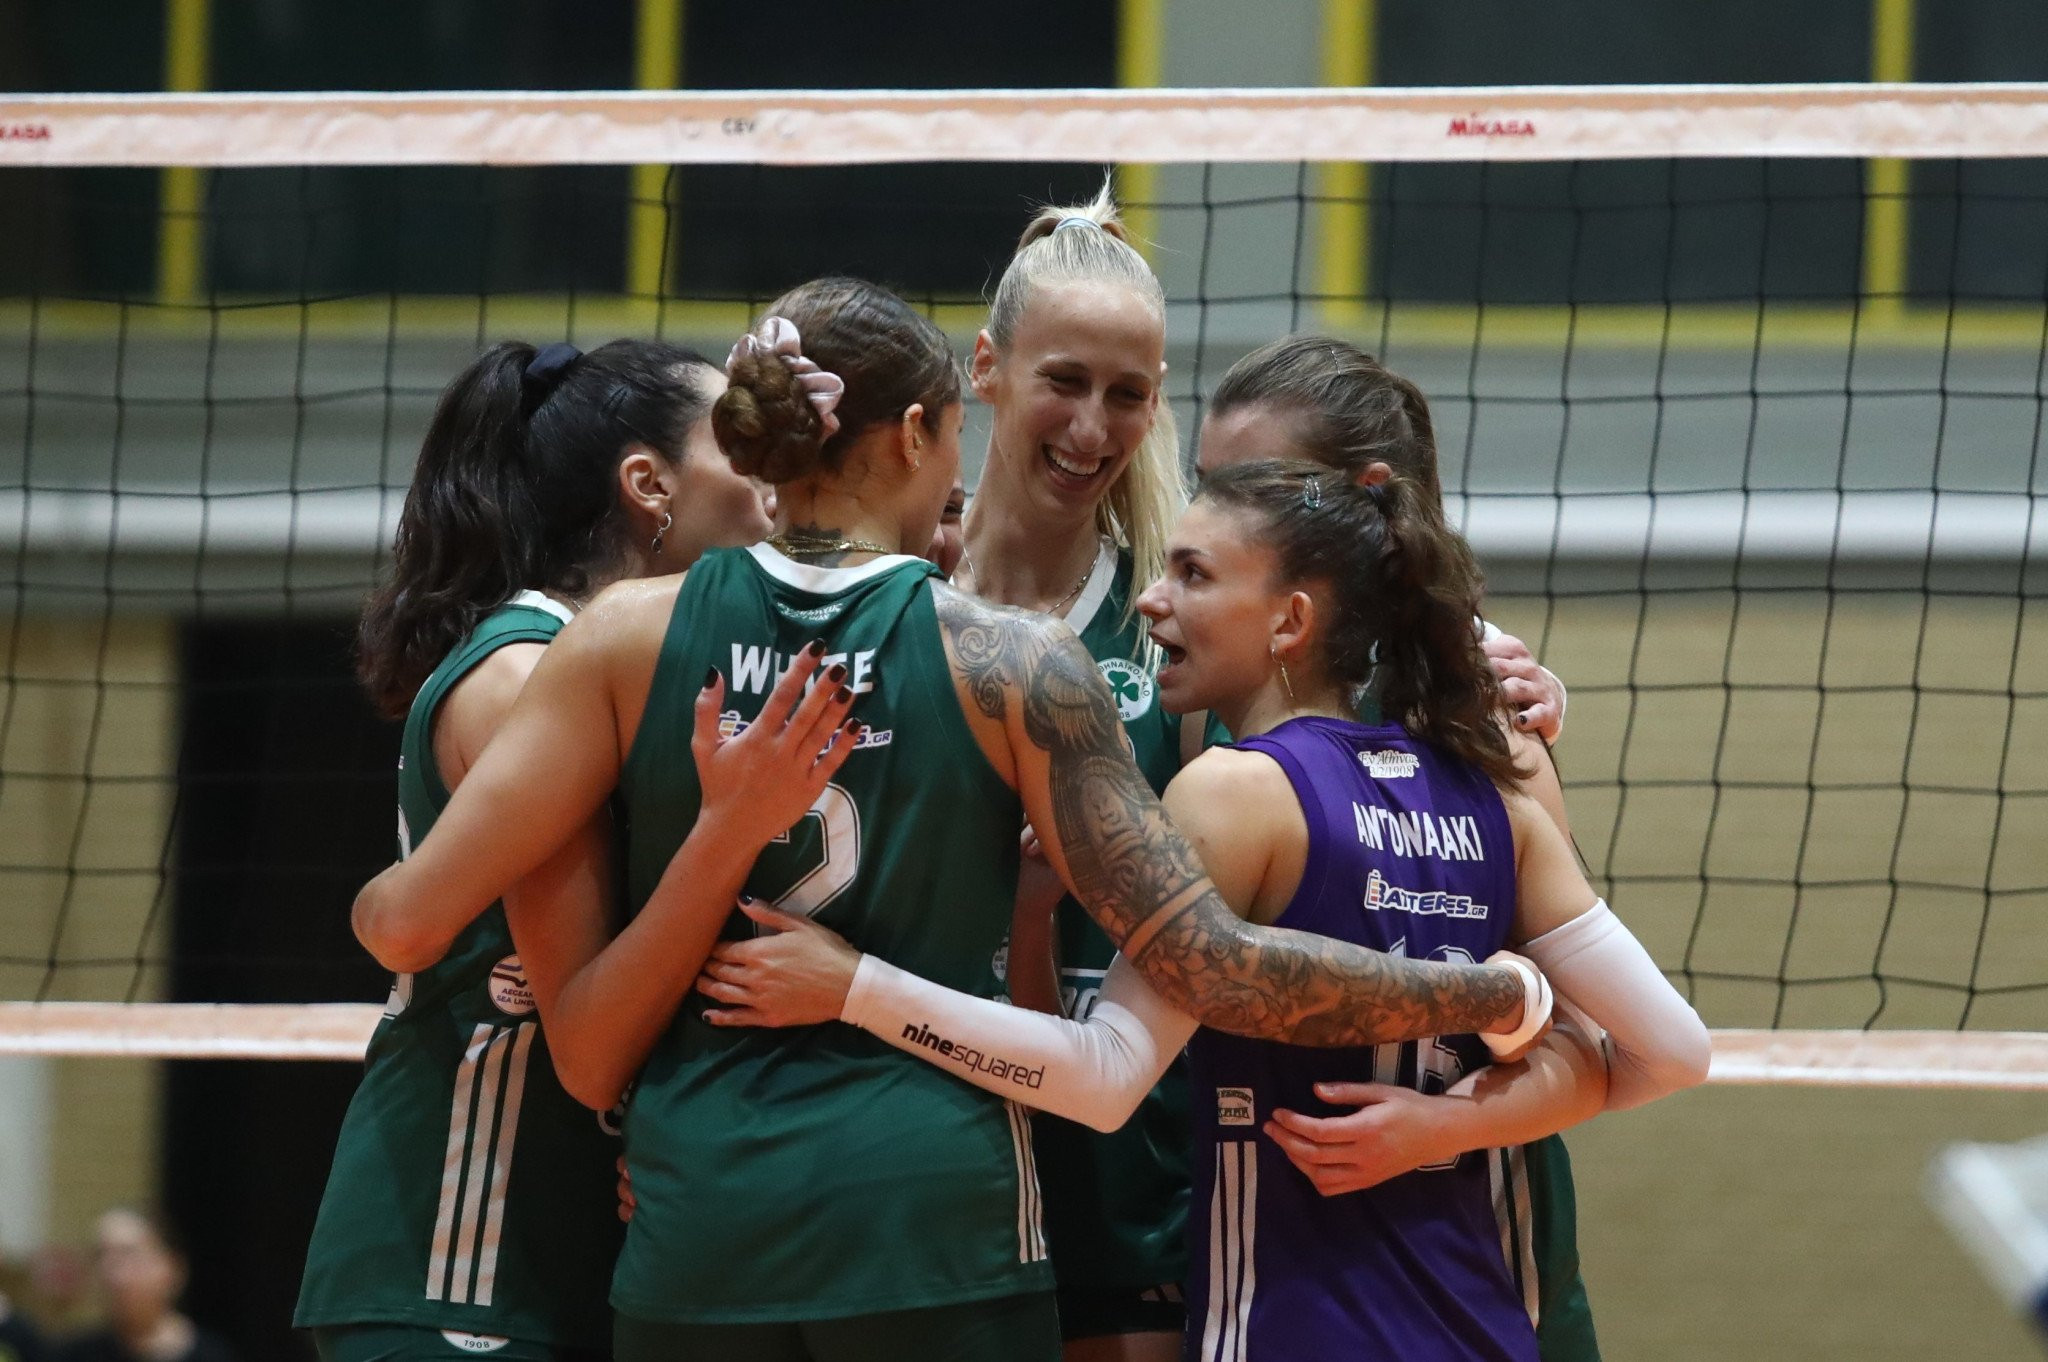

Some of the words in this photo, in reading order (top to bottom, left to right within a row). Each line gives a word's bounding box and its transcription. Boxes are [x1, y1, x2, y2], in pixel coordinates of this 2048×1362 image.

[731, 643, 876, 695] WHTE
[496, 995, 512, 1003] SEA
[901, 1023, 1046, 1090] ninesquared
[464, 1340, 490, 1349] 1908
